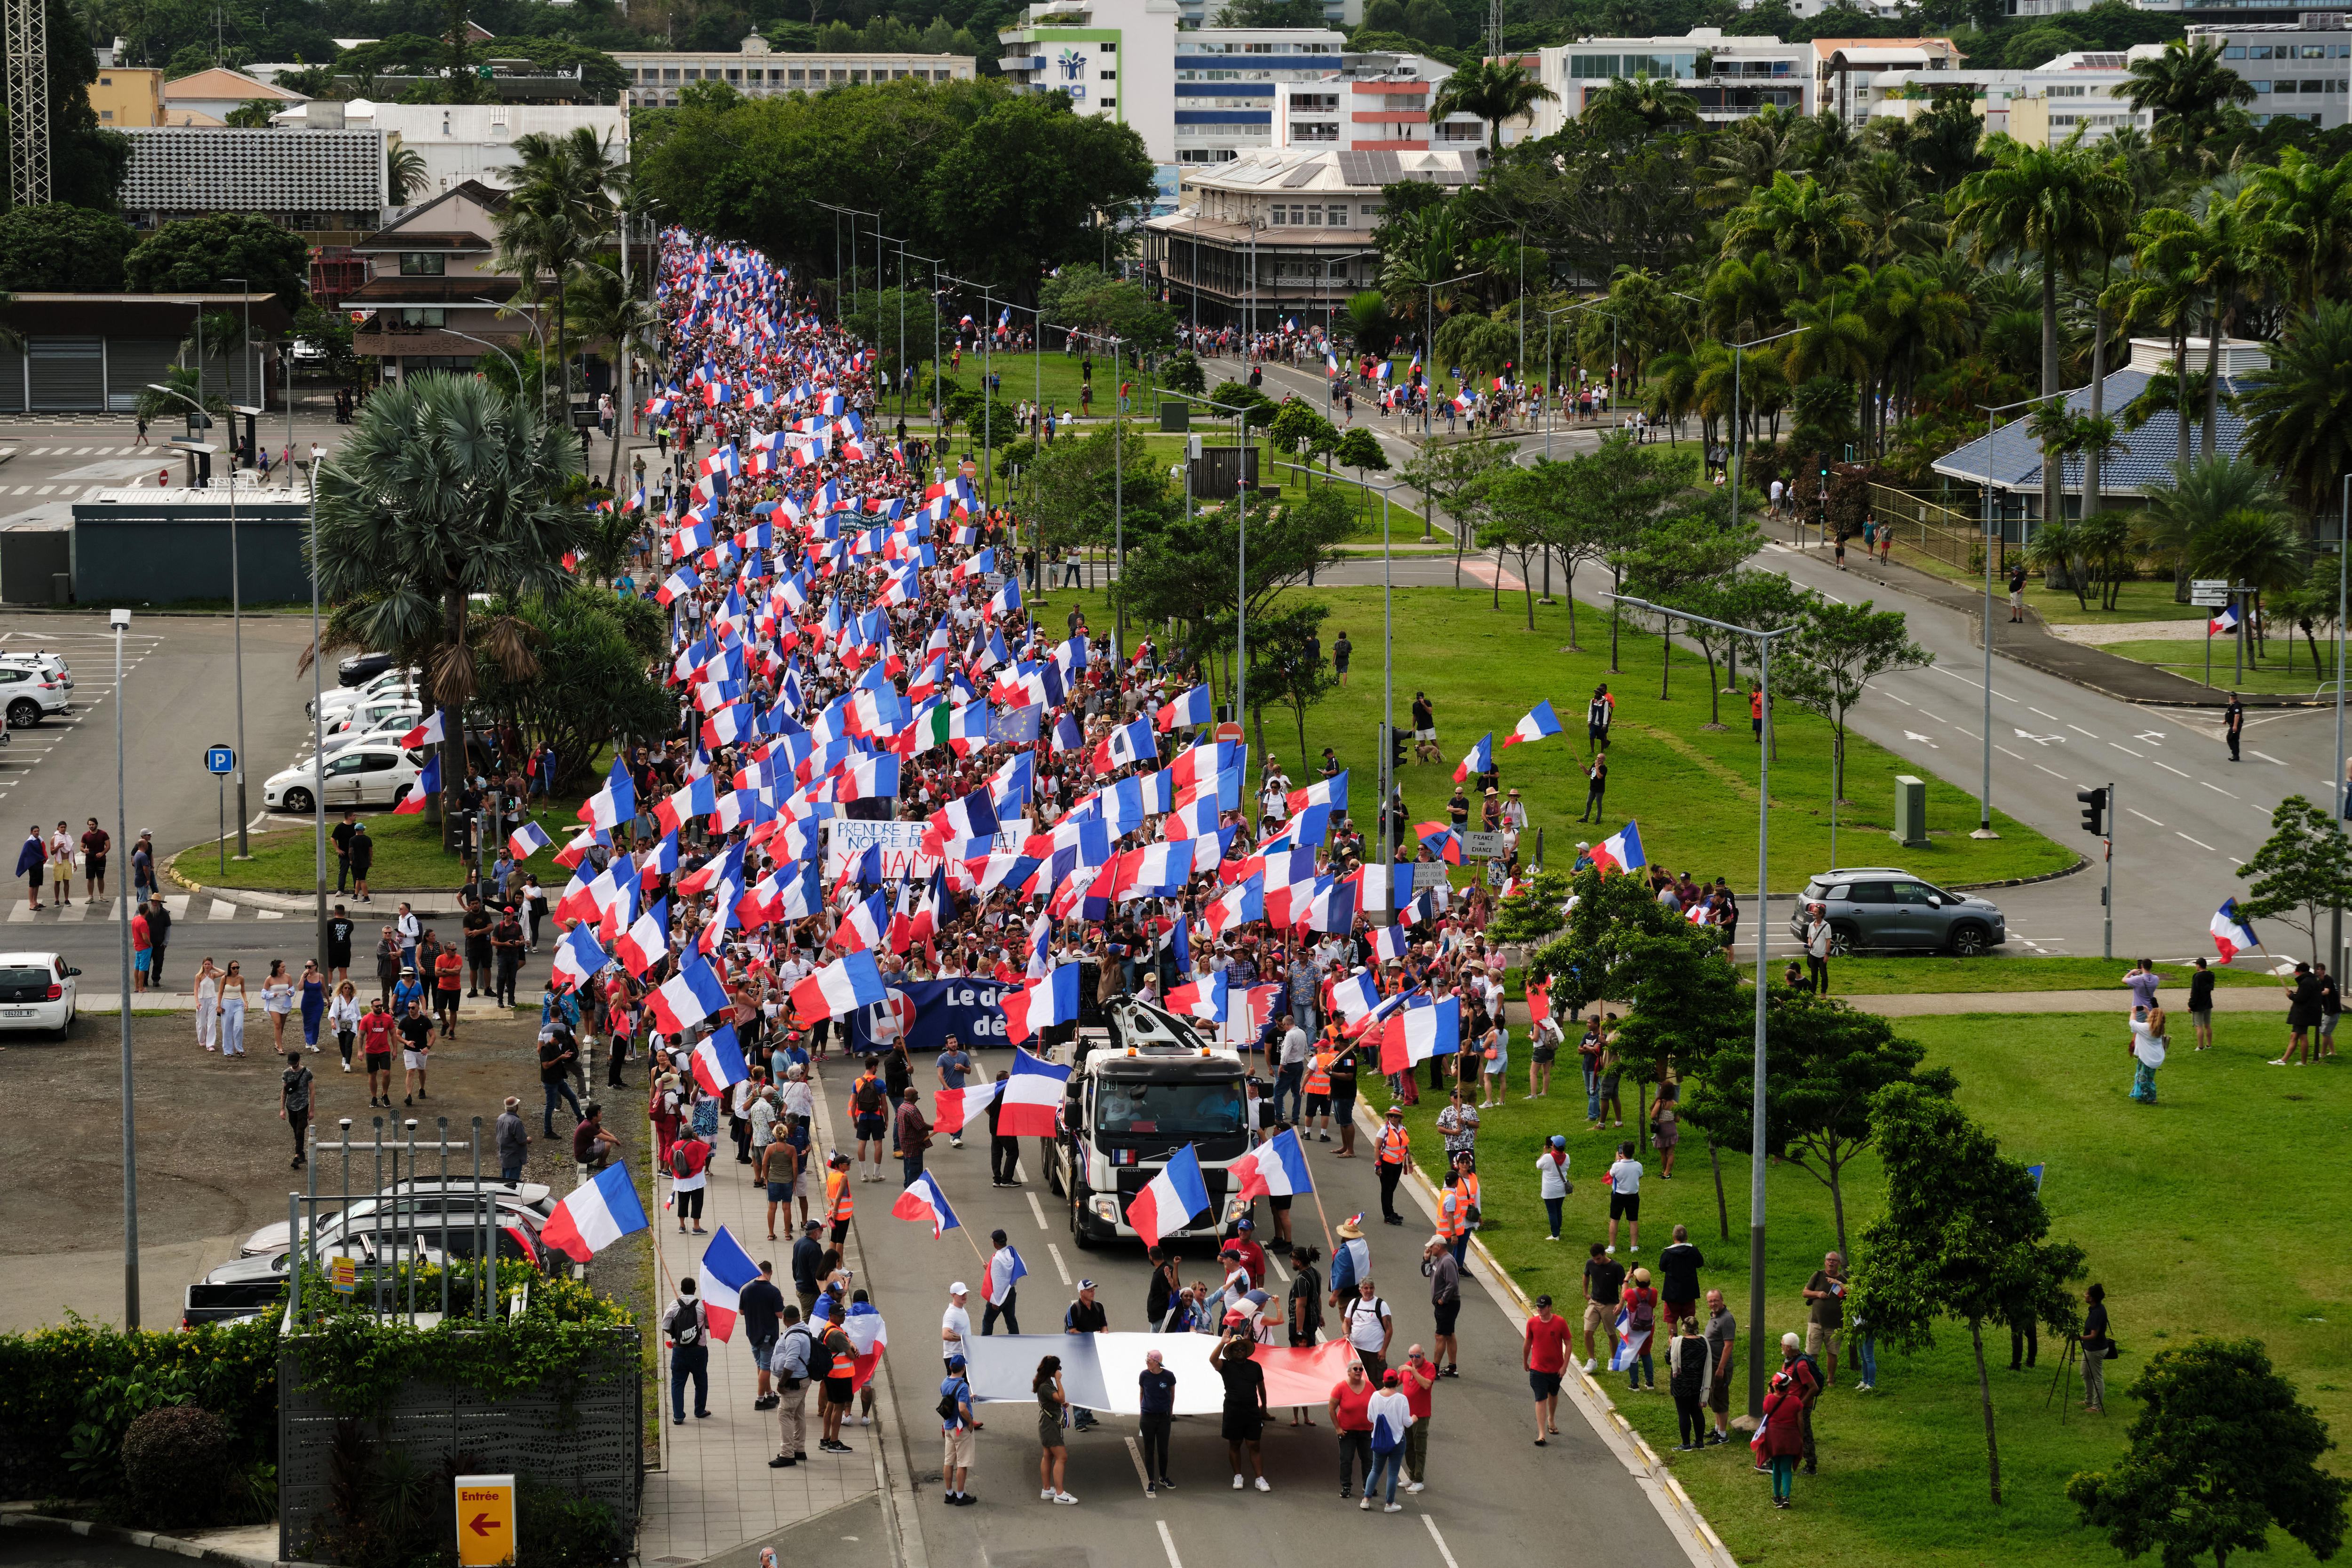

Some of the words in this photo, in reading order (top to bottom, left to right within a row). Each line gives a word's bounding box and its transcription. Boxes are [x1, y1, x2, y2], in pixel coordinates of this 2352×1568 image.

[215, 753, 226, 767] P
[838, 822, 901, 837] PRENDRE
[848, 836, 901, 850] NOTRE
[890, 851, 906, 877] A
[946, 986, 975, 1006] Le
[1145, 1014, 1160, 1028] CORNUT
[1102, 1080, 1116, 1090] 619
[682, 1325, 697, 1340] NIKE
[461, 1491, 499, 1501] Entrée
